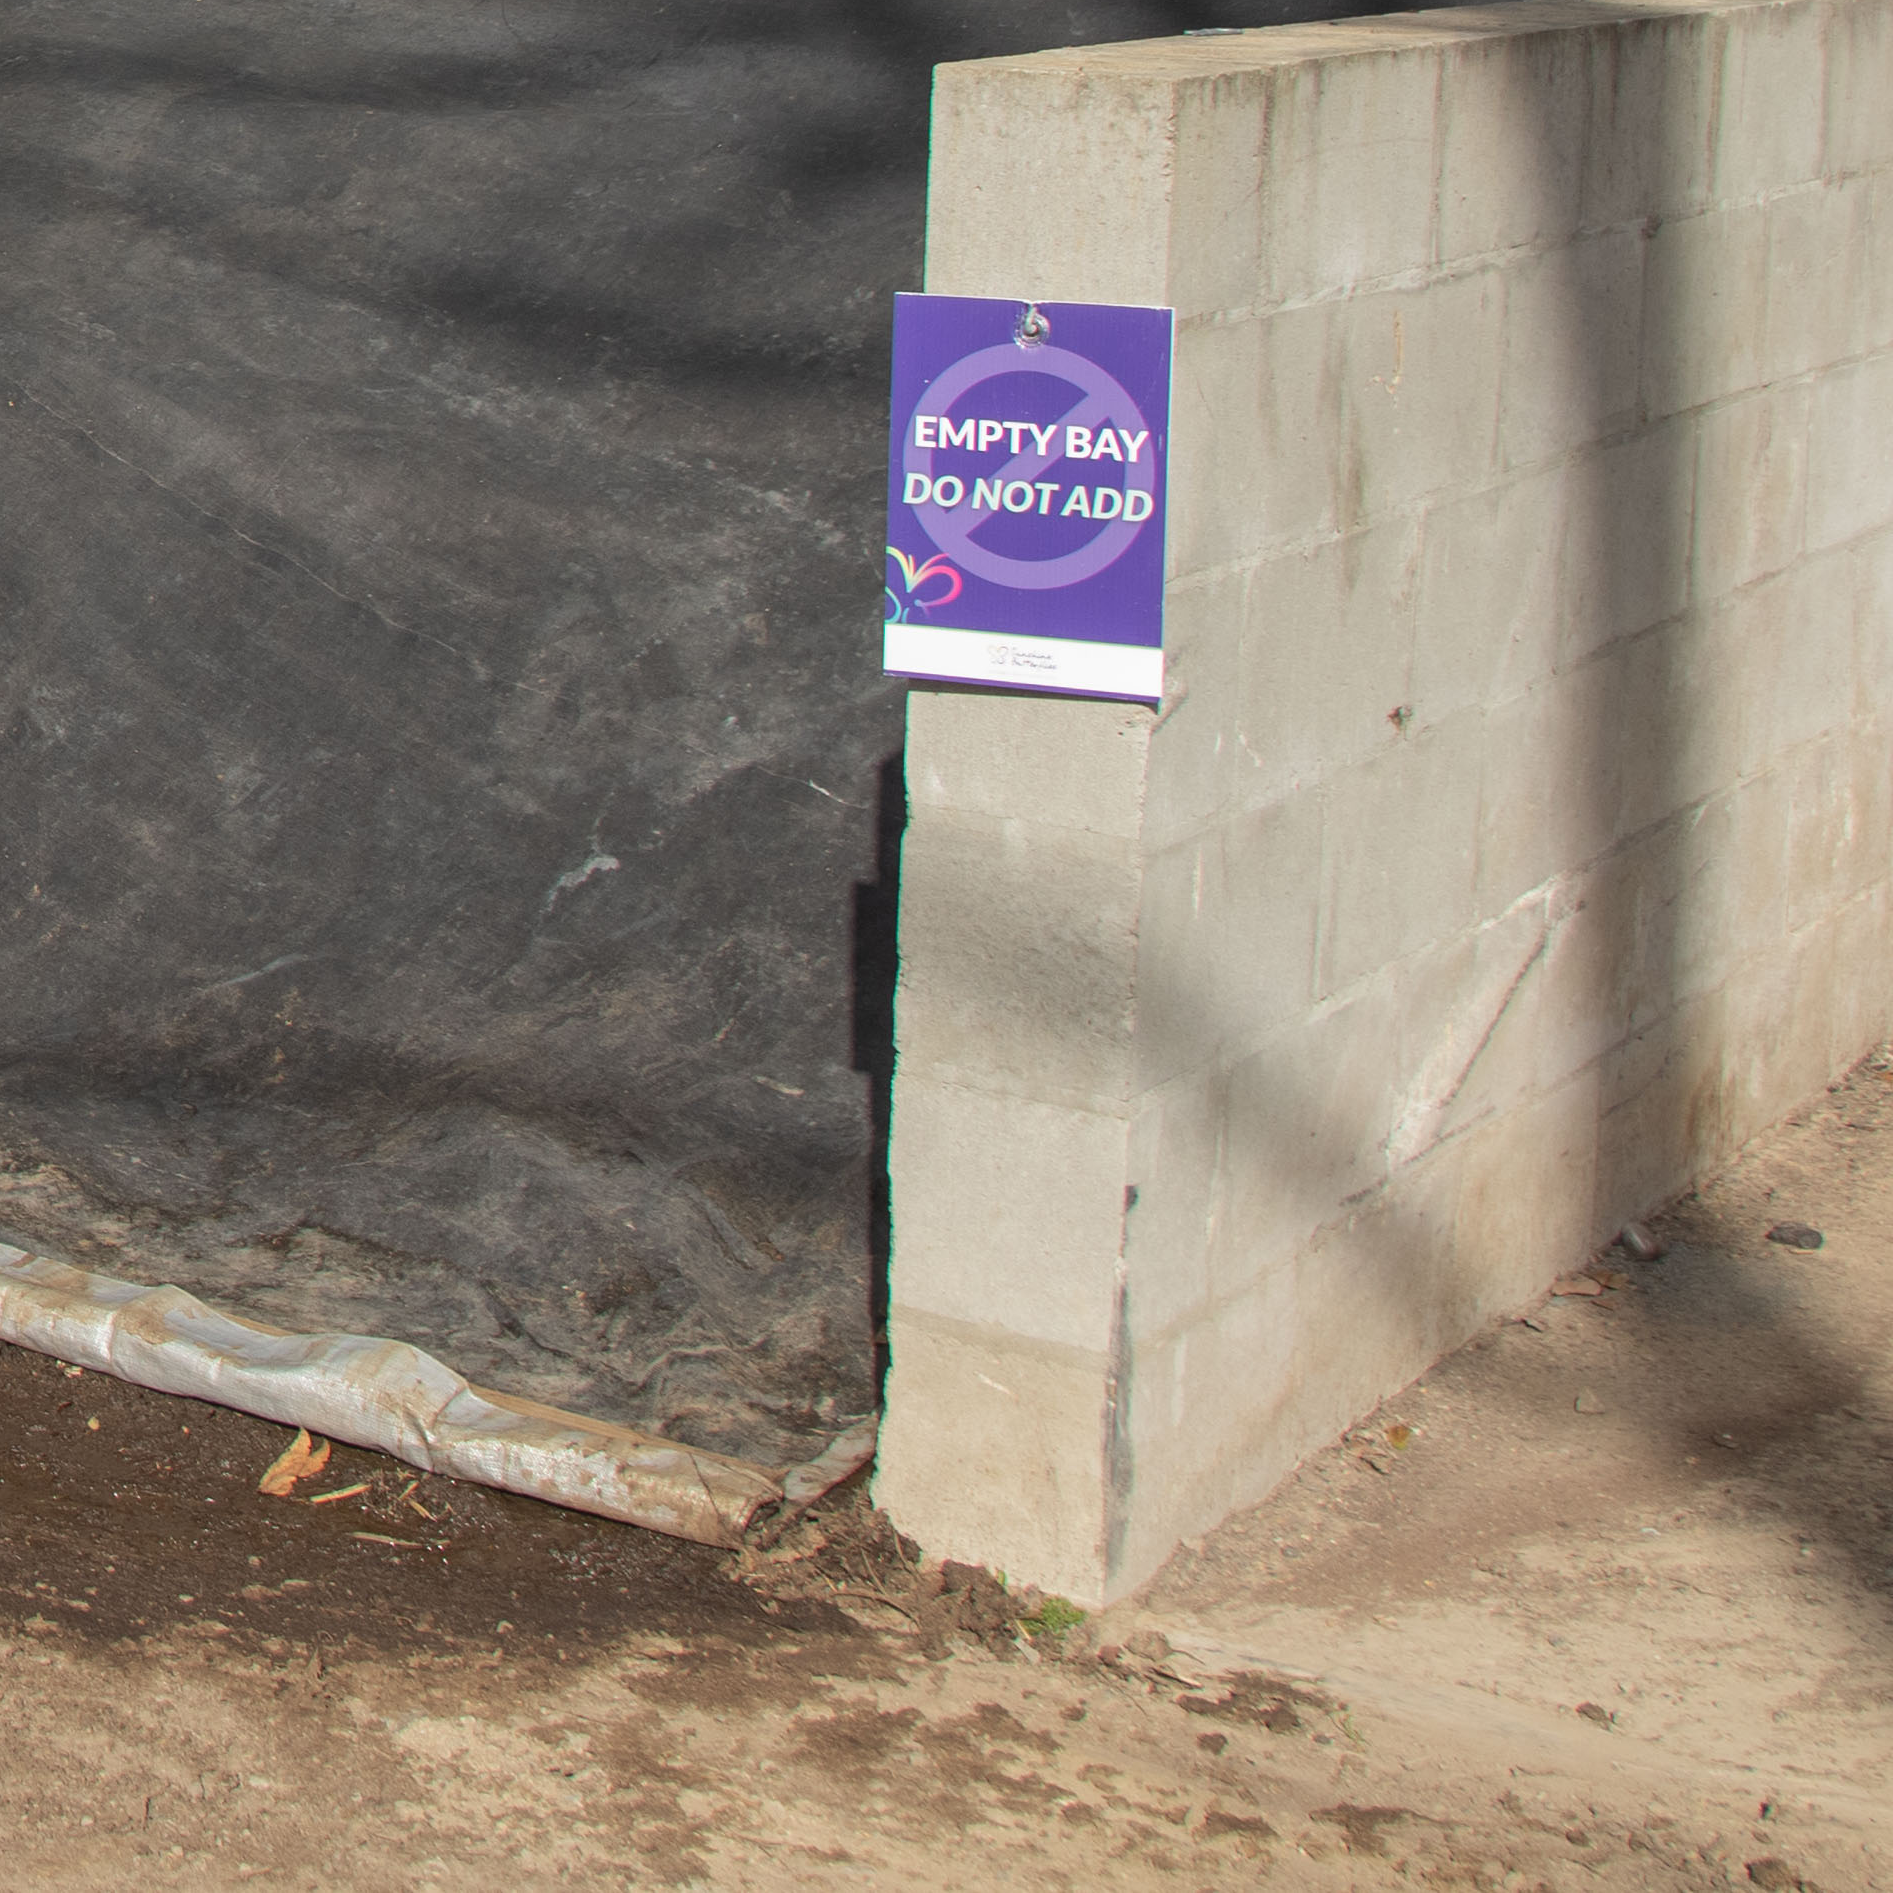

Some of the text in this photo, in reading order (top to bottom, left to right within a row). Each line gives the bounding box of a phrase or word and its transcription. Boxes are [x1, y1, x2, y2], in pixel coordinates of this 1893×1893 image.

[915, 415, 1148, 464] EMPTY BAY
[903, 473, 1153, 522] DO NOT ADD
